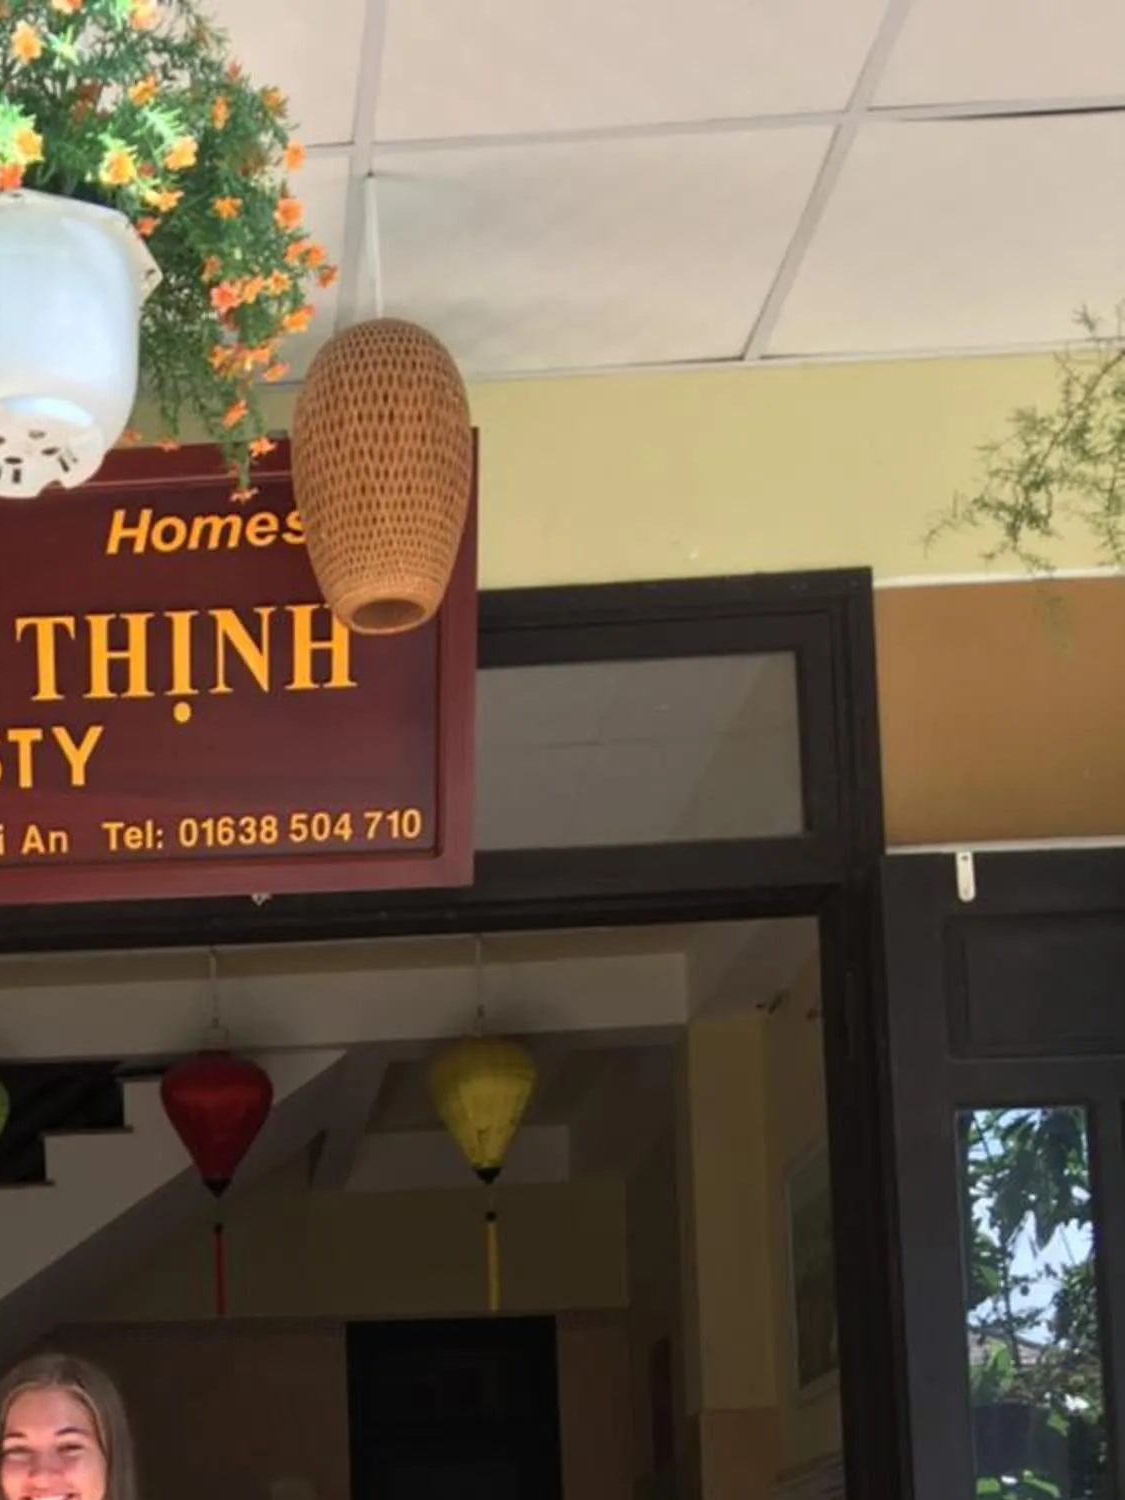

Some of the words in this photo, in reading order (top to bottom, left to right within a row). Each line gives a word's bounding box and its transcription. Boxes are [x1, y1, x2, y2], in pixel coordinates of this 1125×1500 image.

[106, 508, 307, 555] Homes
[15, 603, 357, 723] THỊNH
[21, 824, 68, 855] An
[101, 819, 163, 851] Tel:
[179, 815, 279, 848] 01638
[289, 812, 353, 843] 504
[364, 809, 421, 840] 710
